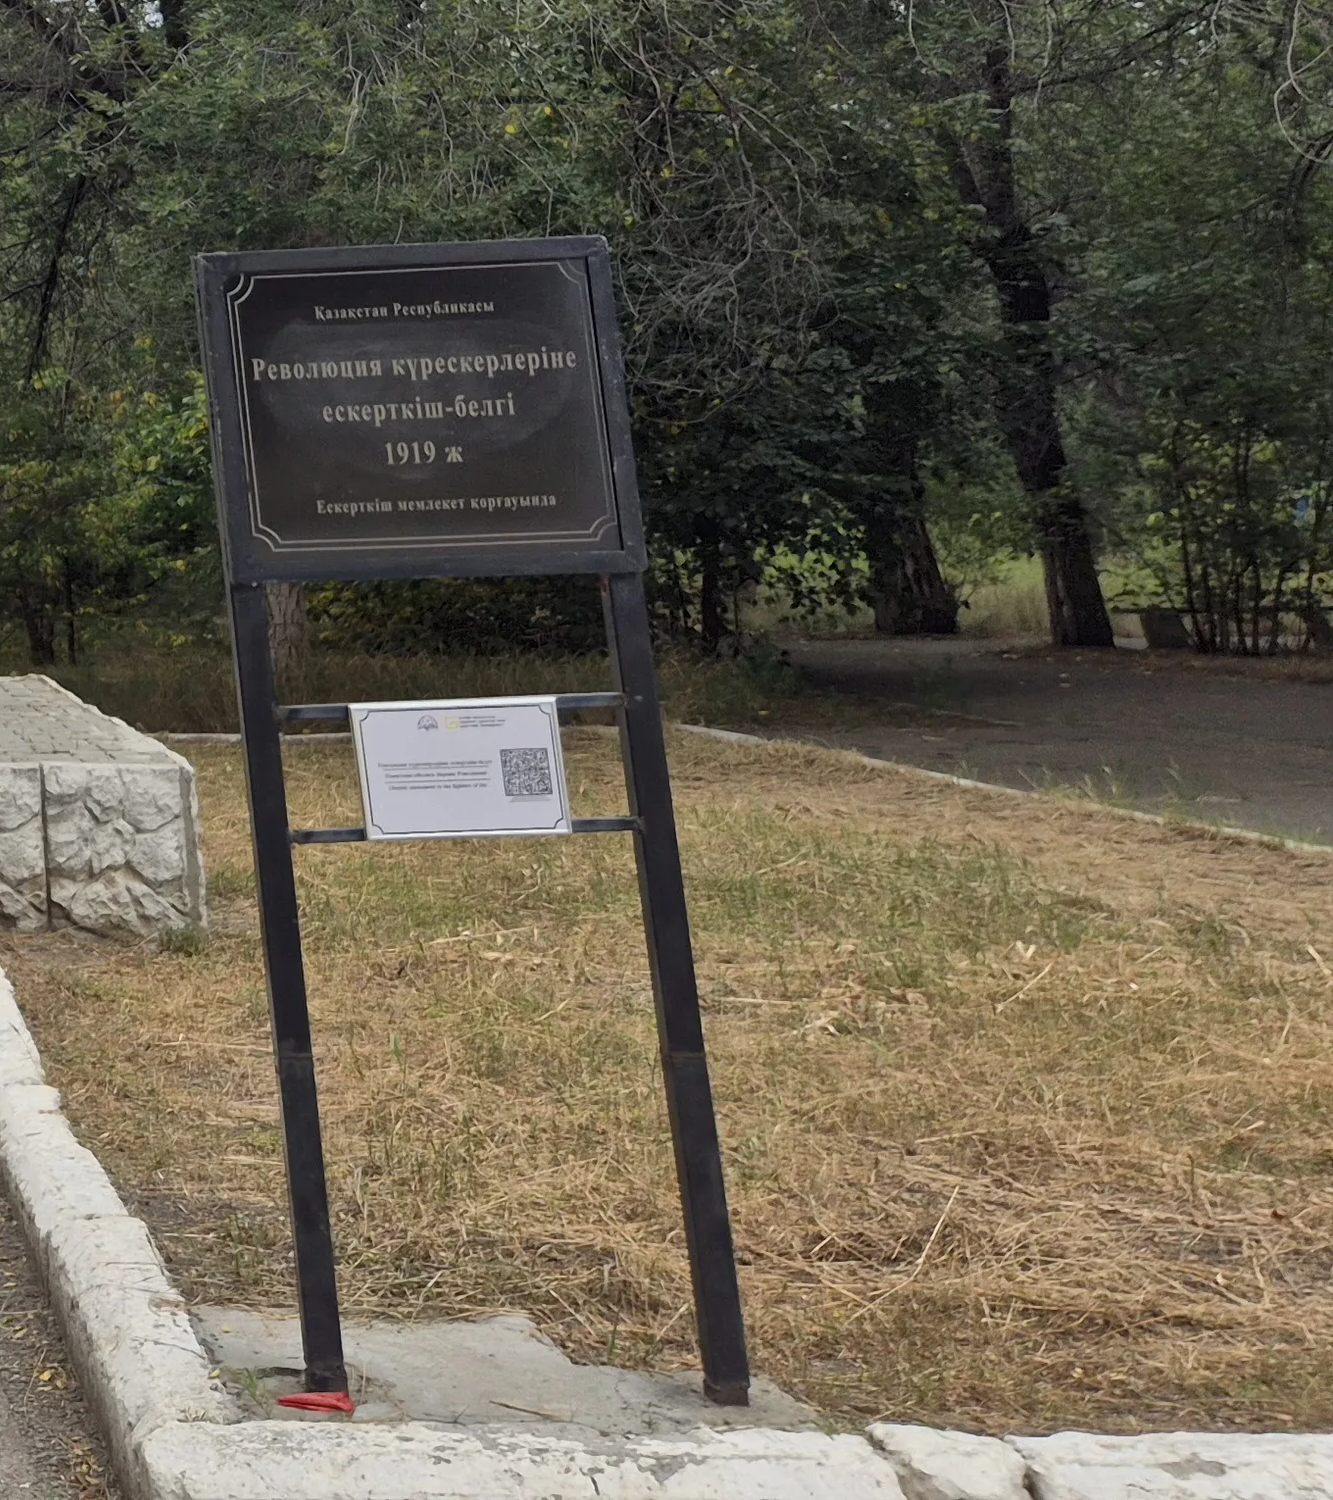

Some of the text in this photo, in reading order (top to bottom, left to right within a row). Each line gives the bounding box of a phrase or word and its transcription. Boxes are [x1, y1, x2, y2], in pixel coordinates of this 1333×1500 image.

[314, 300, 495, 321] Қазақстан Республикасы
[251, 346, 577, 381] Революция күрескерлеріне
[322, 392, 516, 426] ескерткіш-белгі
[384, 441, 464, 466] 1919 ж
[316, 497, 392, 516] Ескерткіш
[397, 497, 465, 511] мемлекет
